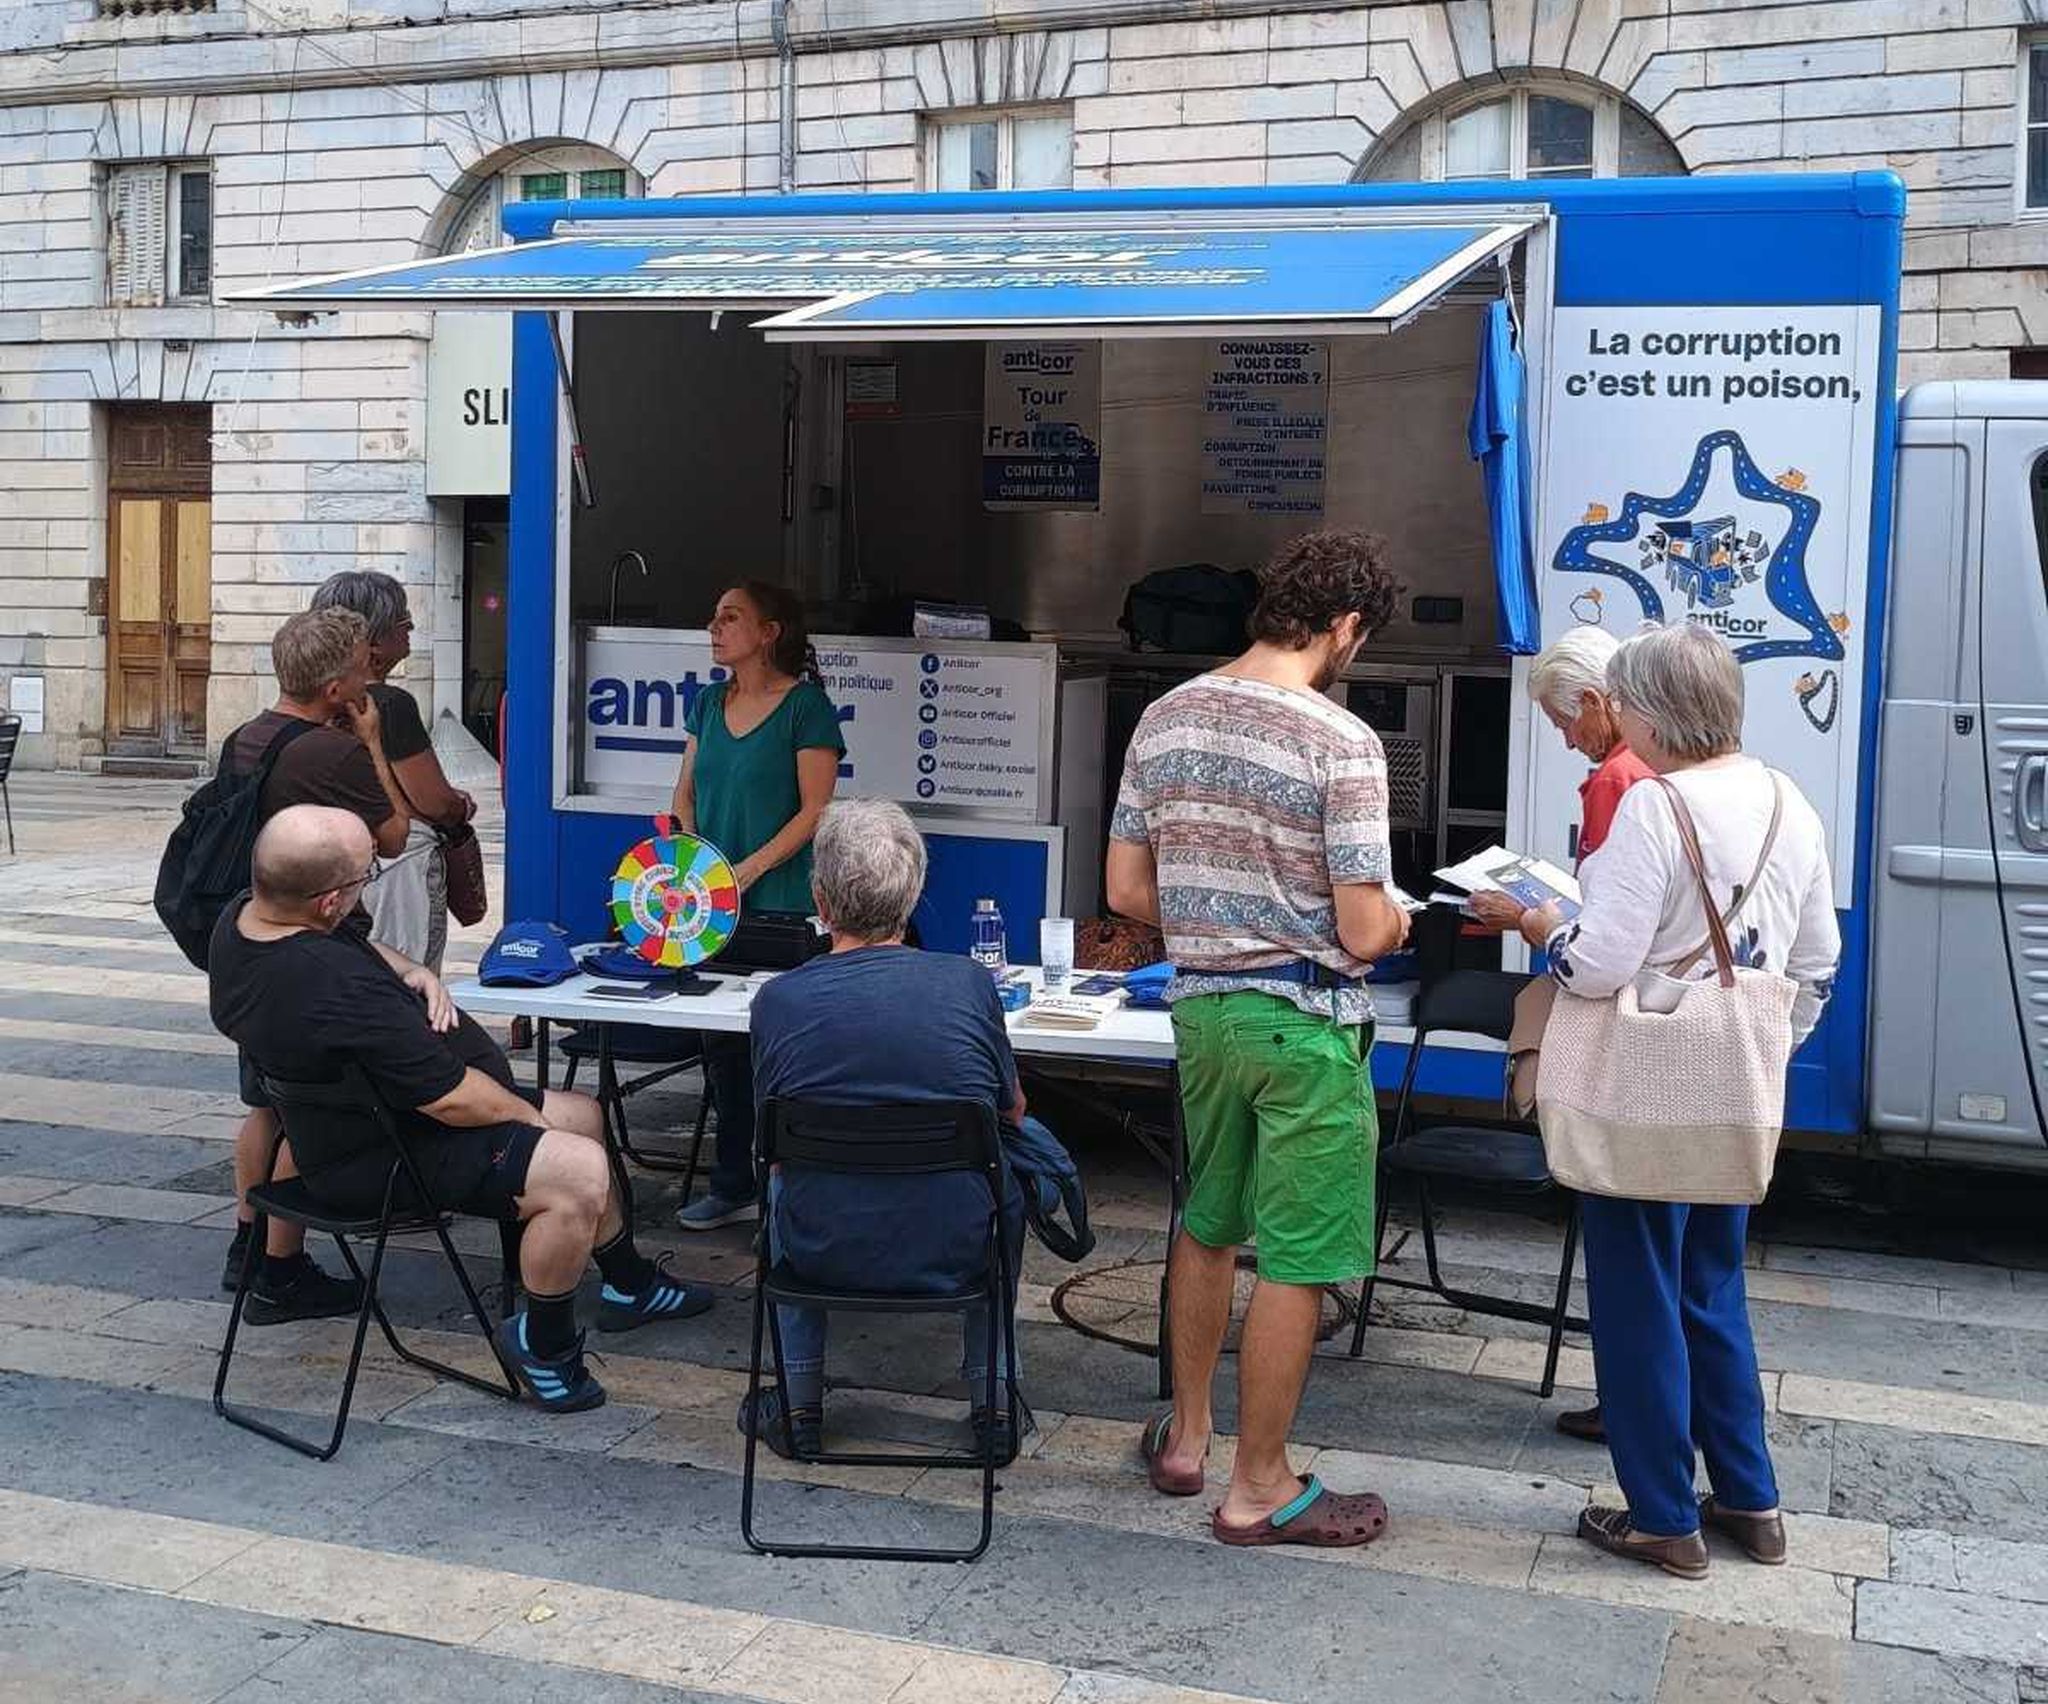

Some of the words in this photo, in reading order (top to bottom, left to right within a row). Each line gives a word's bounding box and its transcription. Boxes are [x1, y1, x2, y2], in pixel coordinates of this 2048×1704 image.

[1220, 343, 1316, 355] CONNAISSEZ-
[1589, 328, 1630, 355] La
[1641, 326, 1841, 362] corruption
[1003, 350, 1074, 370] anticor
[1234, 357, 1270, 369] VOUS
[1275, 357, 1301, 369] CES
[1213, 372, 1309, 384] INFRACTIONS
[1313, 372, 1322, 384] ?
[1566, 370, 1656, 397] c'est
[1667, 374, 1711, 397] un
[1723, 369, 1861, 404] poison,
[1018, 387, 1068, 405] Tour
[464, 388, 508, 425] SLI
[988, 426, 1080, 448] France
[1058, 465, 1076, 478] LA
[839, 674, 893, 692] politique
